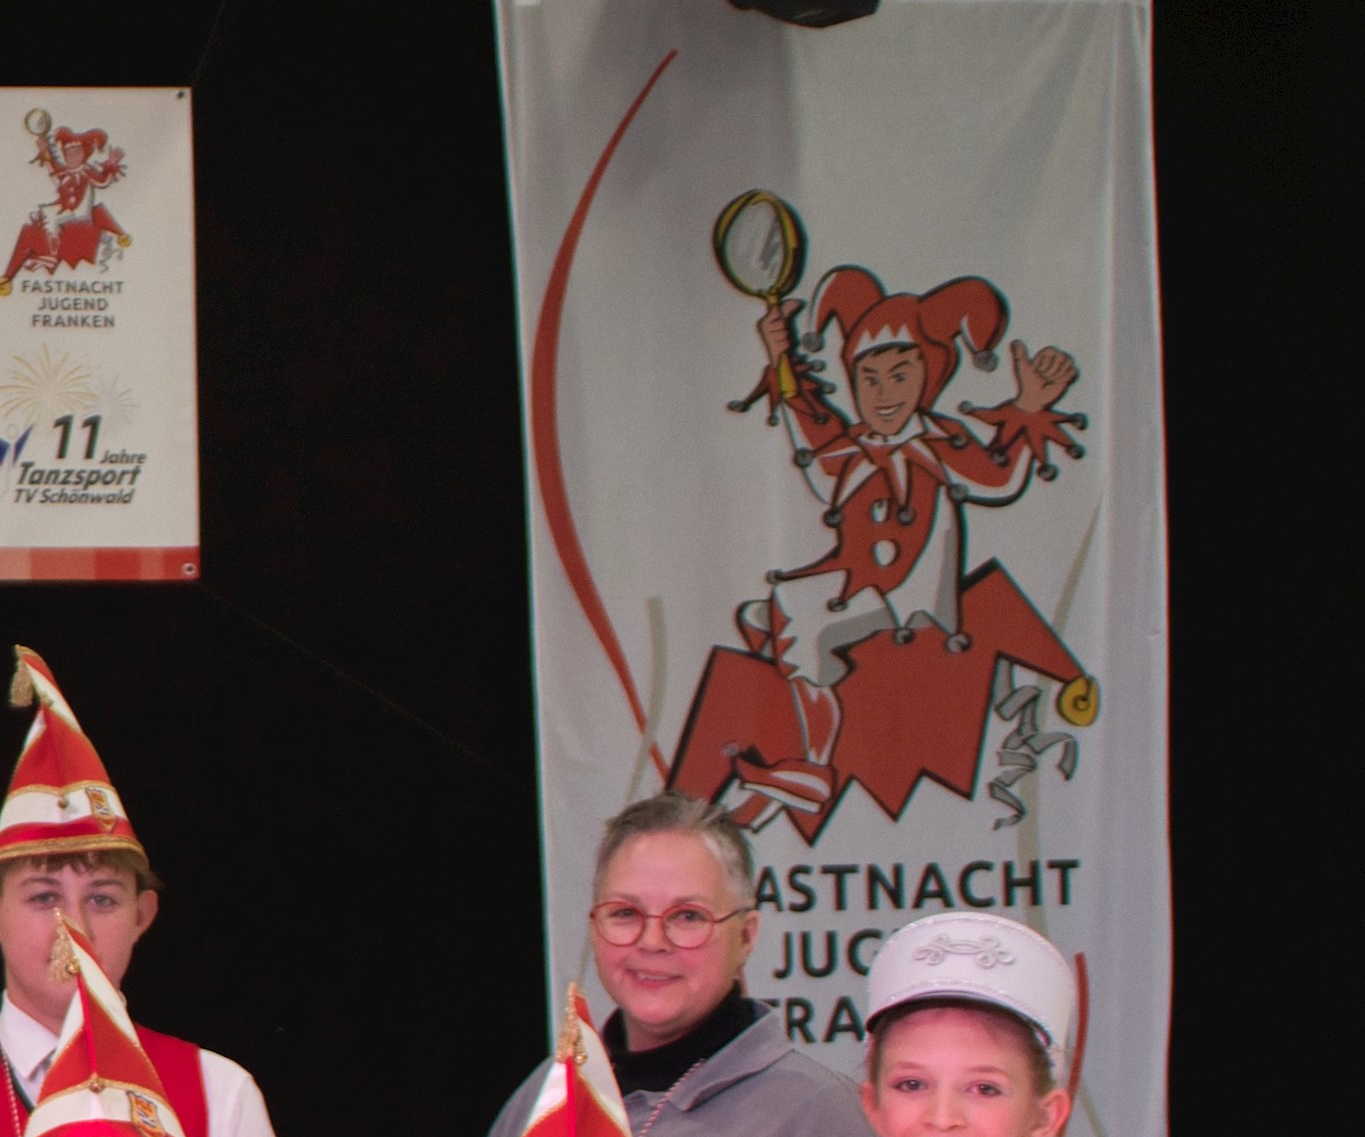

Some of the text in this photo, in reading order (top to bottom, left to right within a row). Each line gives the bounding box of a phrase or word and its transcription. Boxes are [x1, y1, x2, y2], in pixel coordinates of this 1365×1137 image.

[21, 279, 124, 294] FASTNACHT
[38, 297, 109, 311] JUGEND
[31, 313, 116, 328] FRANKEN
[52, 413, 148, 465] 11 Jahre
[16, 460, 142, 491] Tanzsport
[14, 486, 136, 505] TV Schönwald
[754, 858, 1081, 913] ASTNACHT
